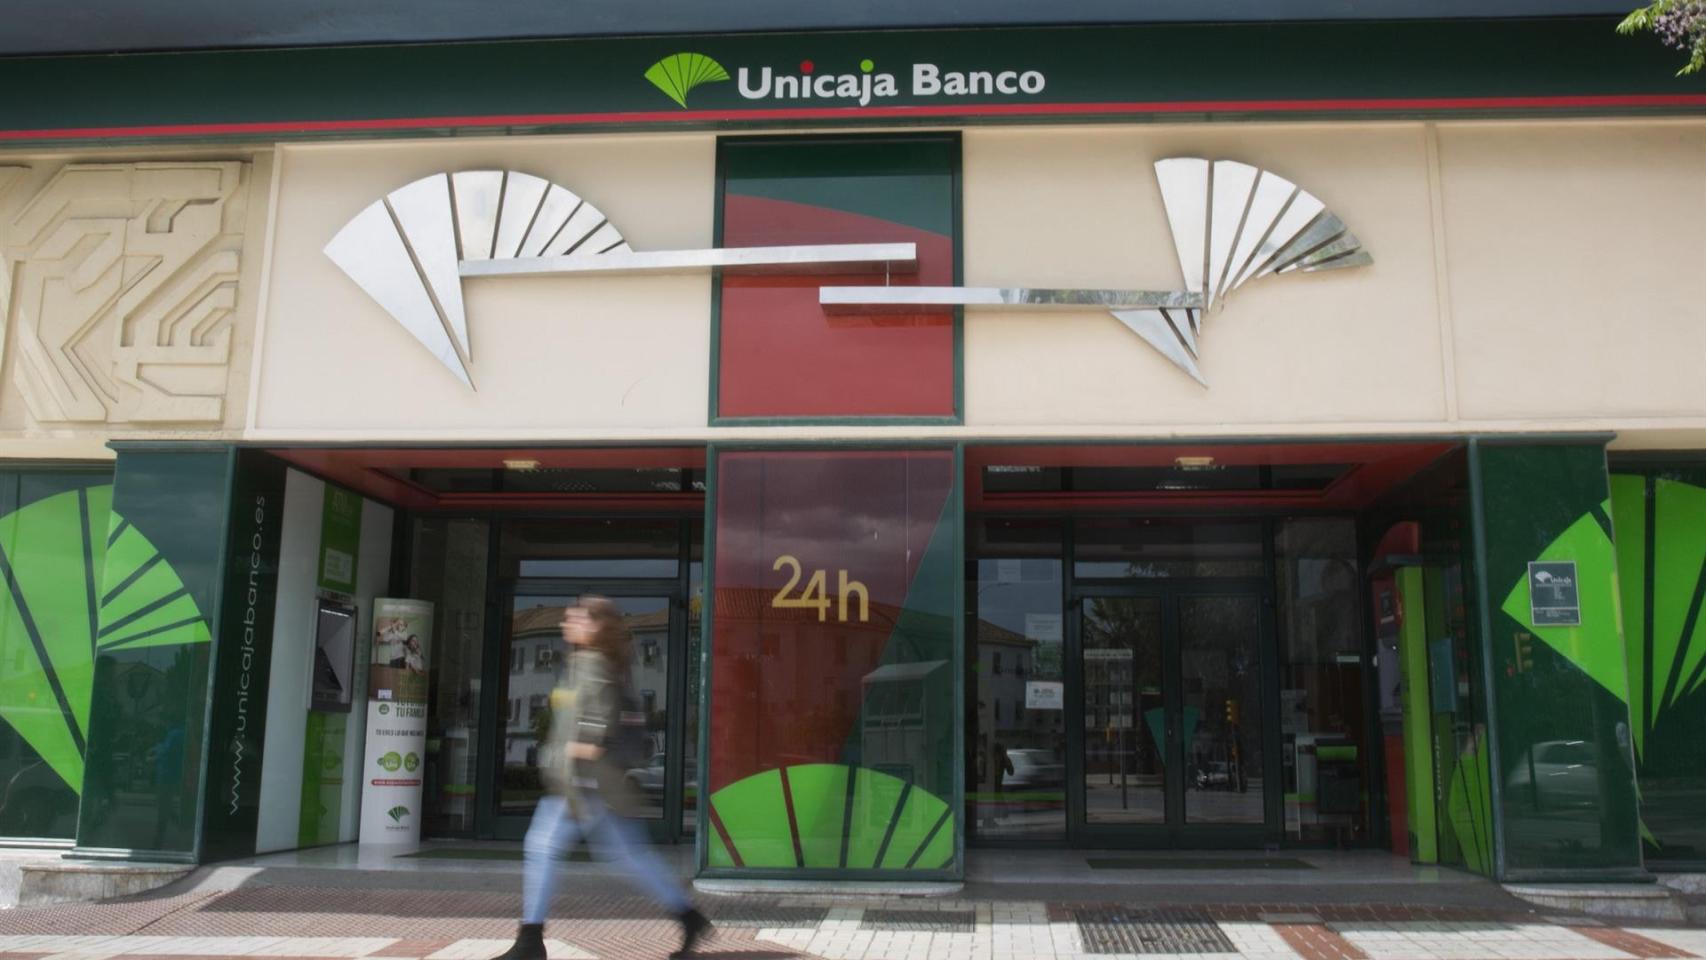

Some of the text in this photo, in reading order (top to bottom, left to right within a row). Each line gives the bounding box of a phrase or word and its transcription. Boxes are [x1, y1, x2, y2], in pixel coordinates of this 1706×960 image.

[737, 59, 1046, 106] Unicaja Banco
[772, 555, 869, 622] 24h
[230, 495, 265, 815] www.unicajabanco.es
